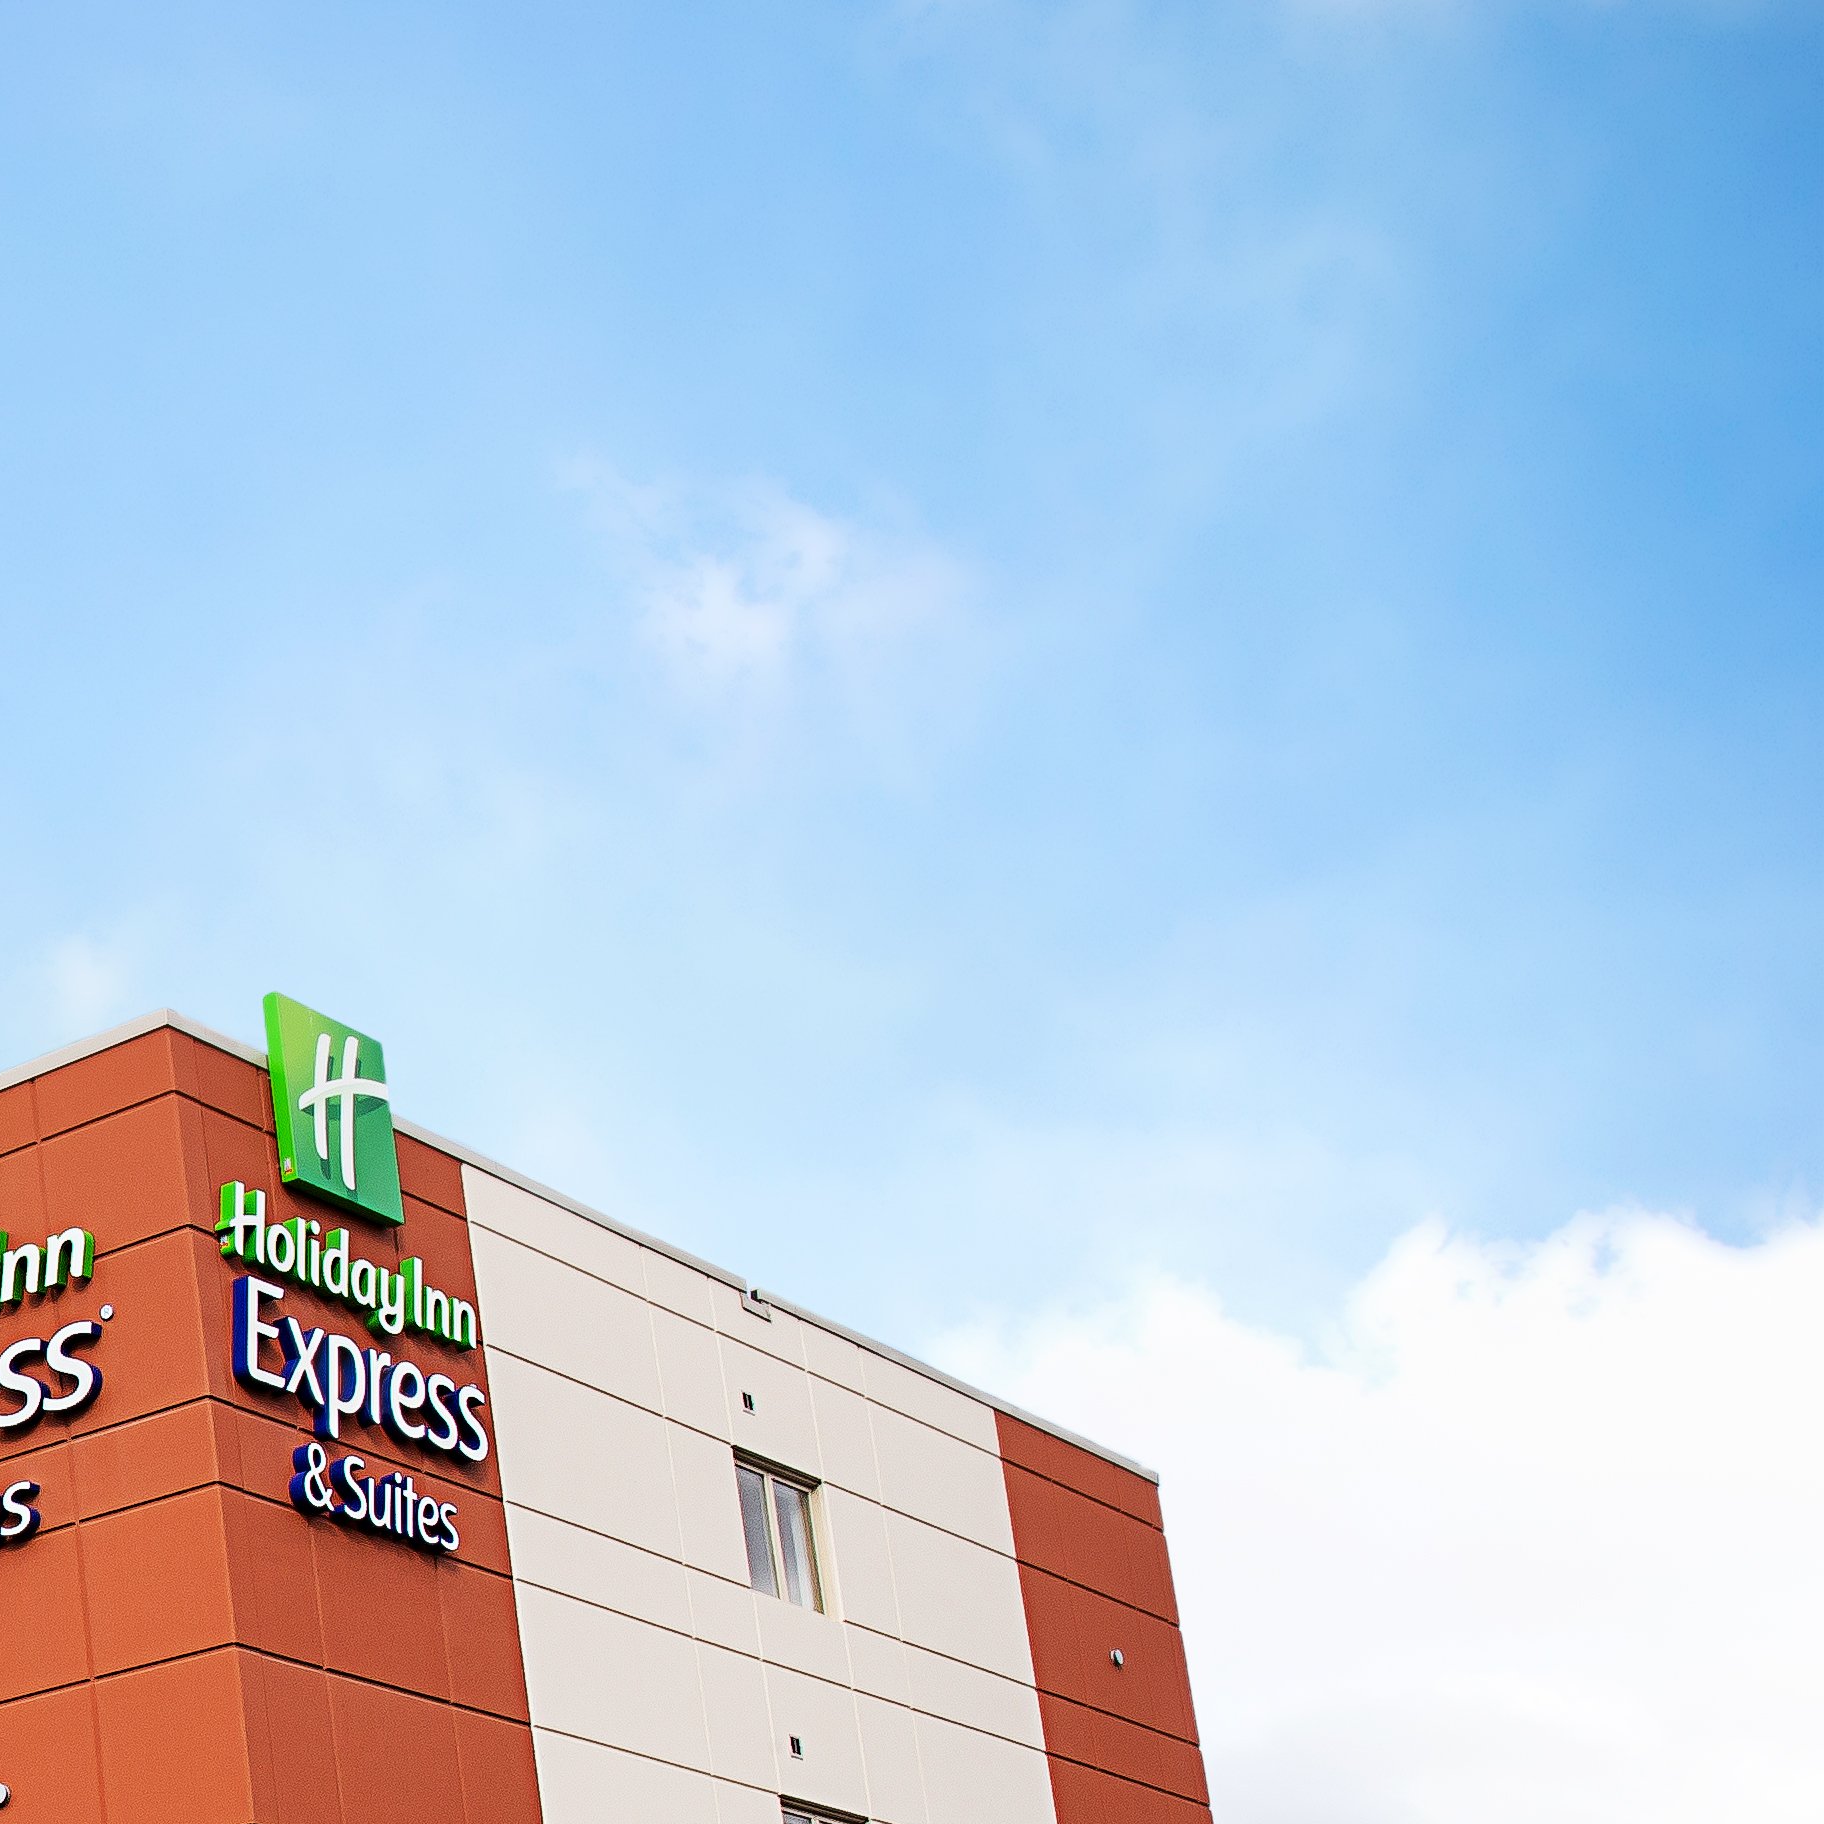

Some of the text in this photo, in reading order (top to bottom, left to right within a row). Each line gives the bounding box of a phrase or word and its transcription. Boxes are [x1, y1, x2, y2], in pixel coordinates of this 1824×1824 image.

[218, 1180, 478, 1351] Holiday Inn
[238, 1274, 489, 1463] Express
[294, 1441, 461, 1551] & Suites
